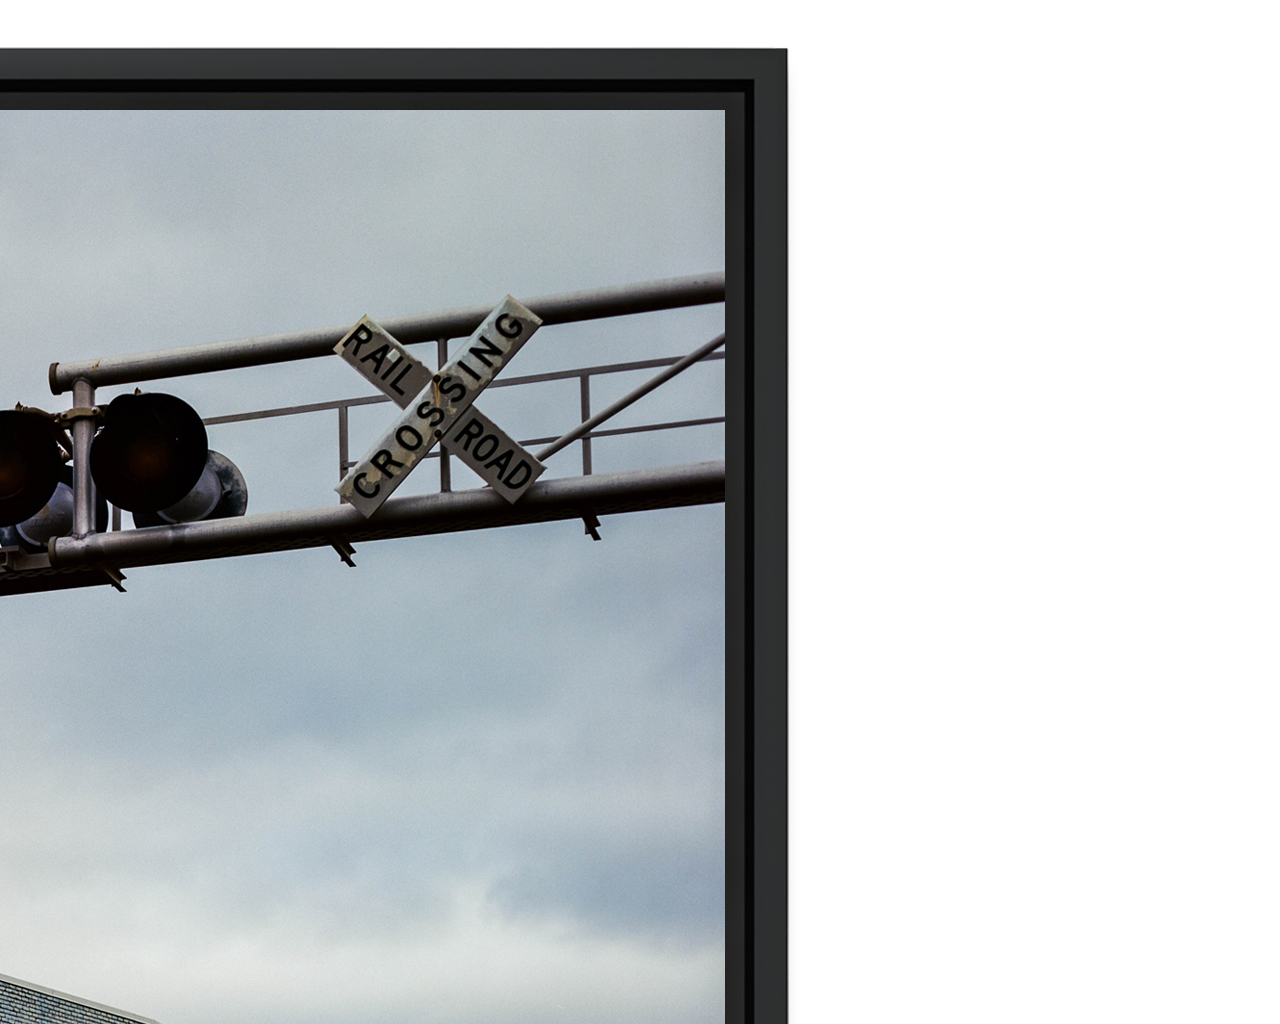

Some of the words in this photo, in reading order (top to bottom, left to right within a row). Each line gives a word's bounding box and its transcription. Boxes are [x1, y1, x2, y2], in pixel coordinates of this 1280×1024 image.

[342, 323, 414, 397] RAIL
[453, 418, 533, 490] ROAD
[352, 313, 523, 499] CROSSING
